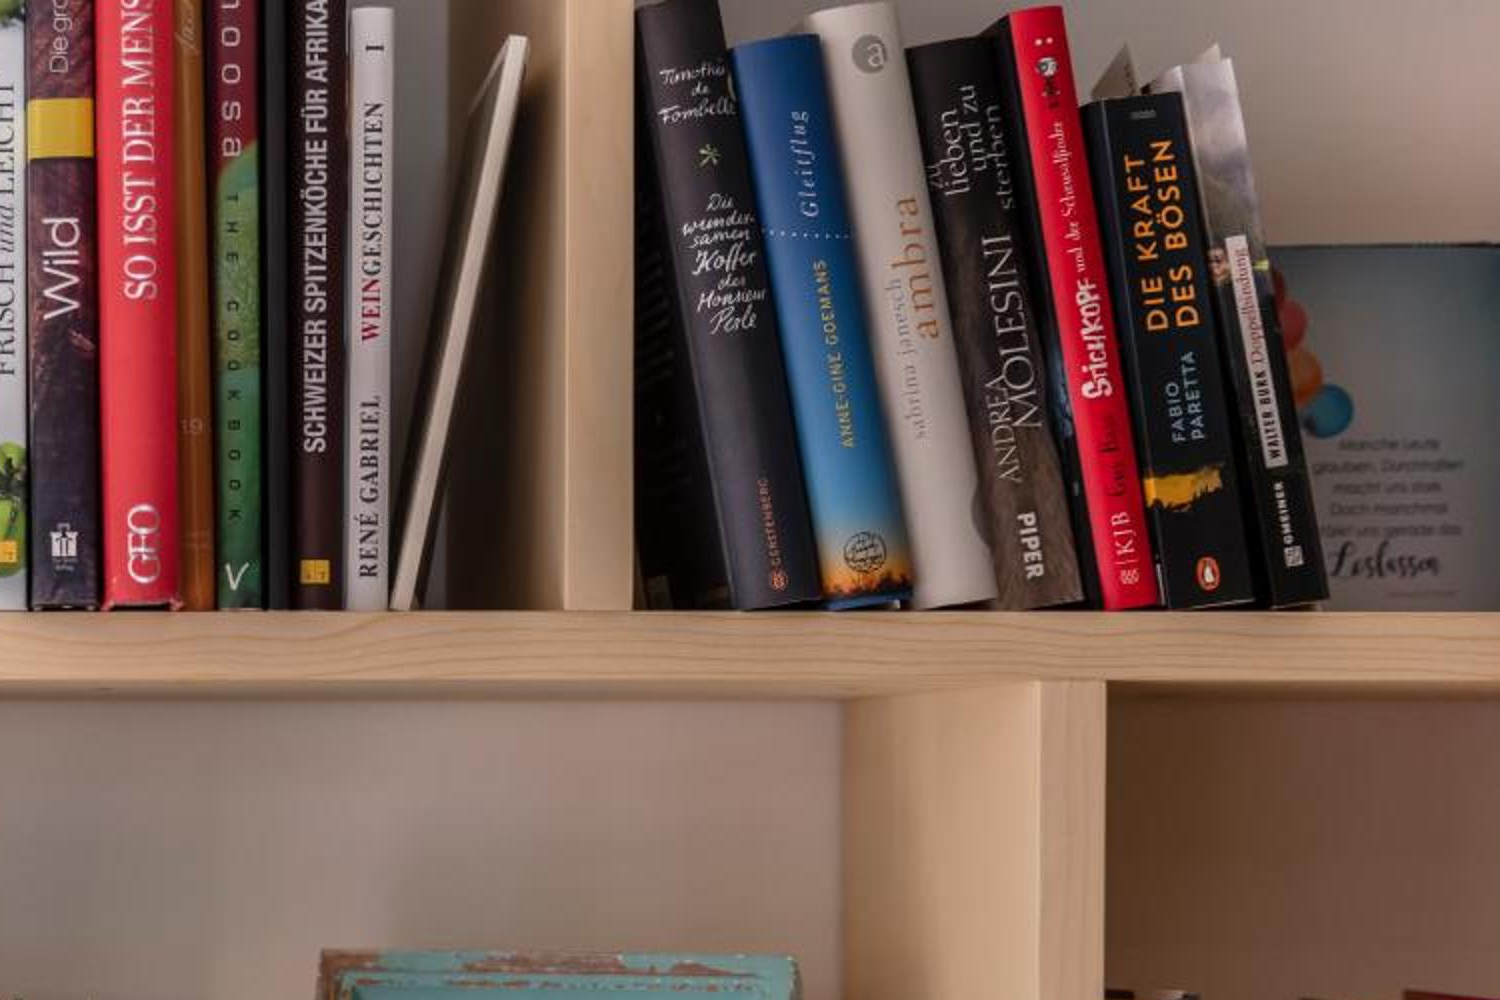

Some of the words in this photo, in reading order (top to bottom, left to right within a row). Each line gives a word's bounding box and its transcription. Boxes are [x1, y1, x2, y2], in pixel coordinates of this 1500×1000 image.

[51, 33, 70, 75] Die
[304, 0, 329, 83] AFRIKA
[121, 95, 156, 163] DER
[301, 84, 329, 133] FÜR
[959, 84, 978, 114] zu
[790, 111, 819, 217] Gleitflug
[941, 108, 970, 197] lieben
[964, 120, 987, 172] und
[987, 102, 1013, 209] sterben
[122, 172, 158, 245] ISST
[227, 194, 240, 262] THE
[301, 141, 329, 312] SPITZENKÖCHE
[361, 103, 384, 341] WEINGESCHICHTEN
[706, 193, 734, 211] Die
[1125, 154, 1157, 262] KRAFT
[1151, 139, 1188, 250] BÖSEN
[41, 217, 80, 320] Wild
[689, 229, 751, 249] samen
[692, 245, 756, 274] Koffer
[897, 197, 940, 340] ambra
[123, 254, 158, 300] SO
[697, 288, 765, 312] Monsieur
[717, 271, 745, 290] des
[813, 260, 837, 346] GOEMANS
[885, 265, 915, 356] janesch
[1141, 276, 1169, 331] DIE
[1169, 264, 1200, 328] DES
[982, 235, 1042, 428] MOLESINI
[303, 319, 328, 453] SCHWEIZER
[823, 352, 855, 448] ANNE-GINE
[903, 365, 929, 441] sabrina
[1165, 382, 1187, 443] FABIO
[1181, 351, 1205, 440] PARETTA
[1254, 372, 1274, 408] BURK
[360, 396, 381, 503] GABRIEL
[984, 373, 1022, 483] ANDREA
[1261, 410, 1282, 460] WALTER
[127, 504, 161, 584] GEO
[354, 513, 379, 578] RENÉ
[1017, 512, 1044, 580] PIPER
